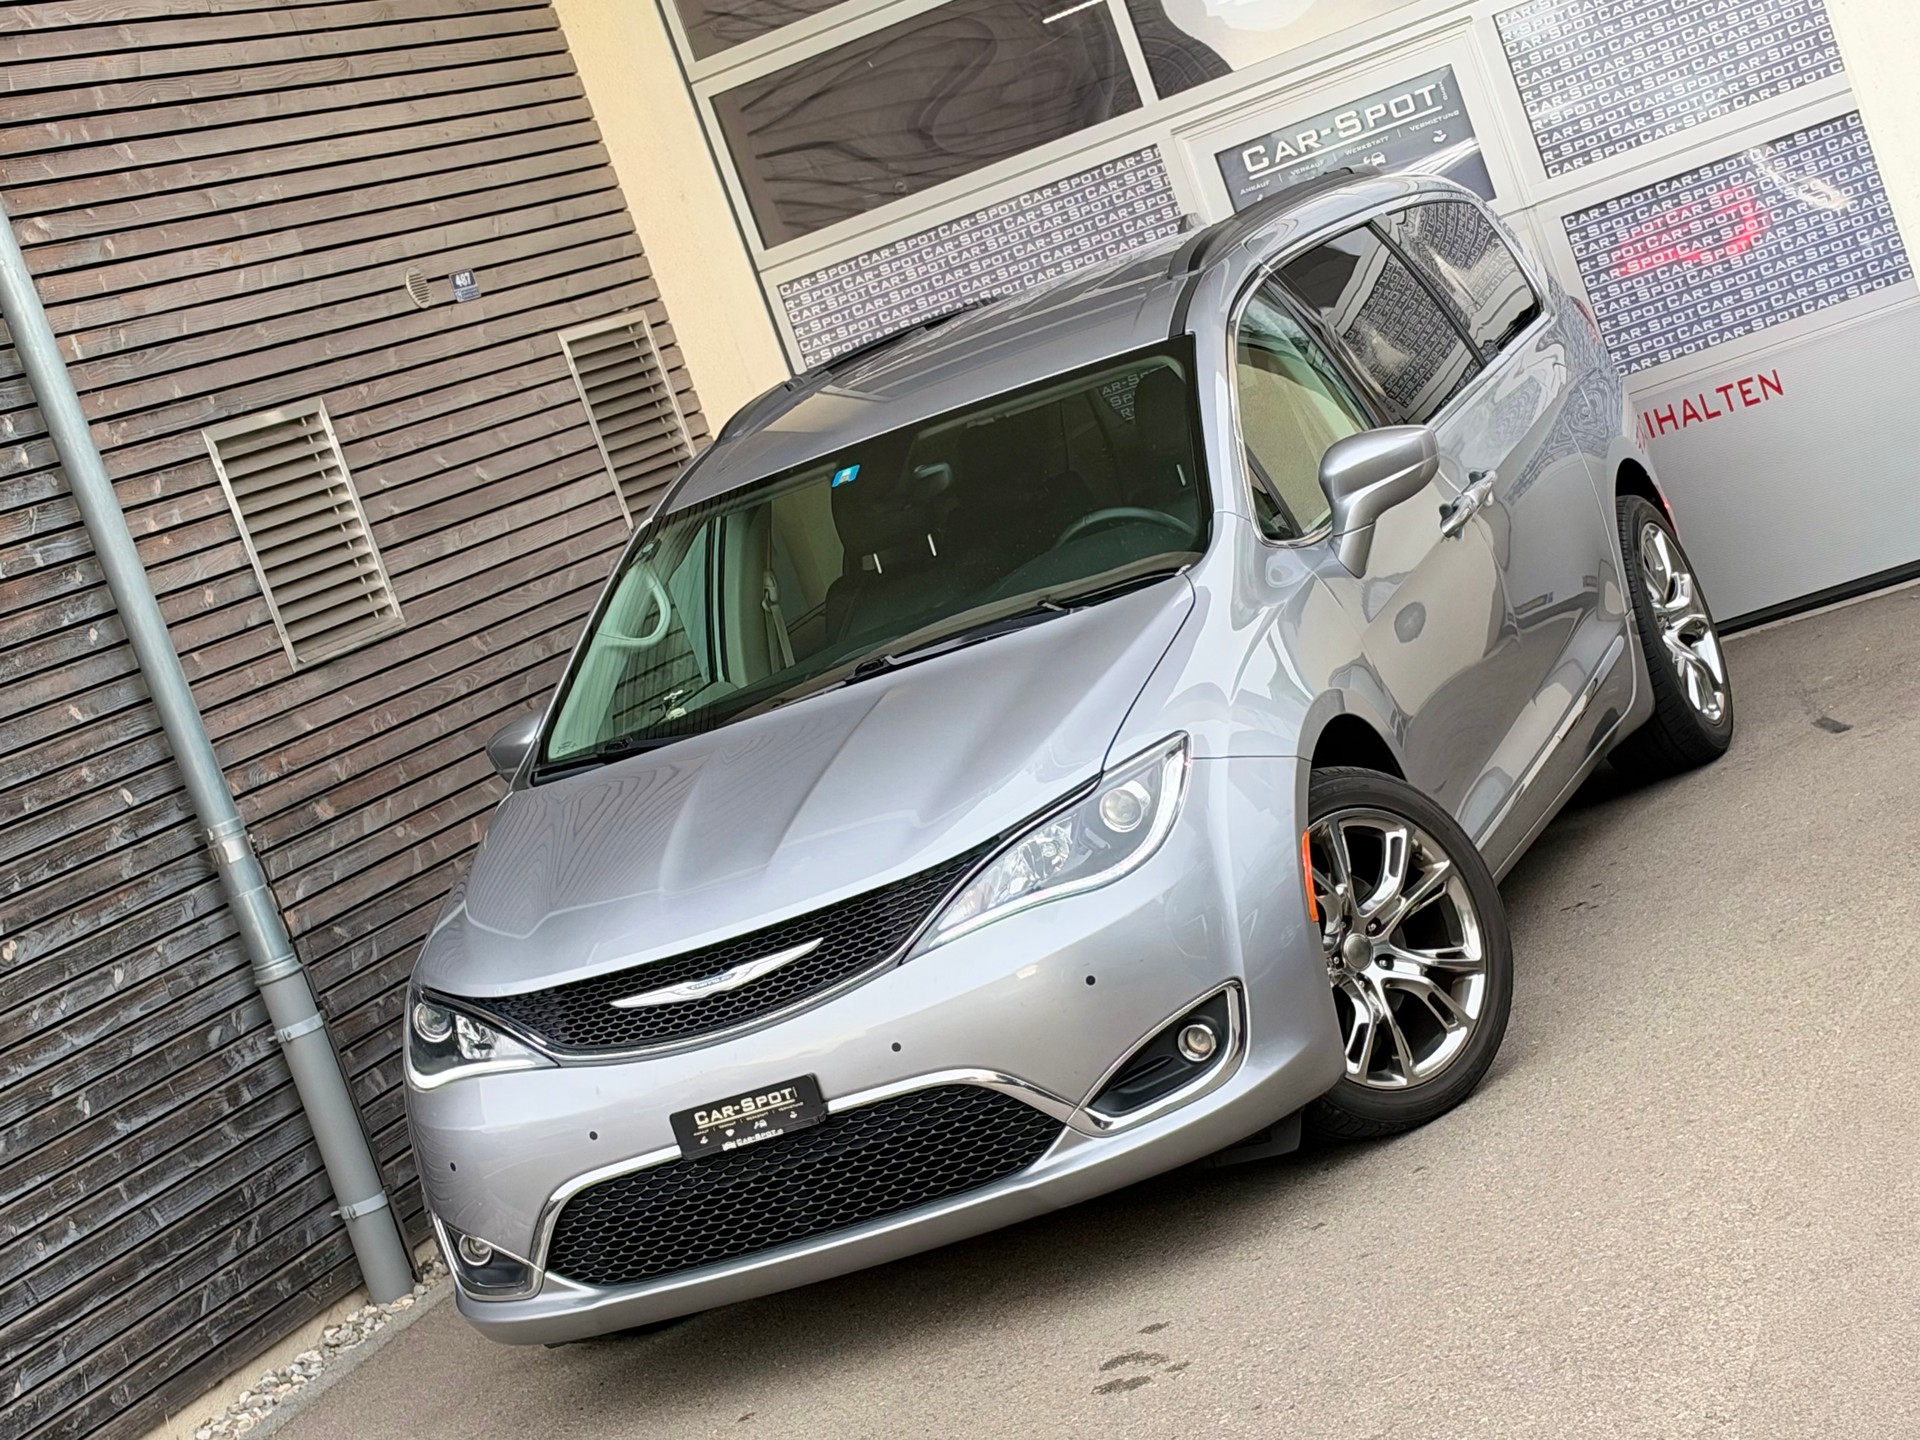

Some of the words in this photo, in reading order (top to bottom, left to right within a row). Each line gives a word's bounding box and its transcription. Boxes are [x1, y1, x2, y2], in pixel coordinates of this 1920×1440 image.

[1240, 180, 1270, 195] ANKAUF
[1290, 159, 1326, 176] VERKAUF
[1344, 136, 1390, 156] WERKSTATT
[1409, 110, 1460, 132] VERMIETUNG
[1242, 84, 1436, 172] CAR-SPOT
[455, 272, 471, 288] 487
[694, 1087, 792, 1125] CAR-SPOT
